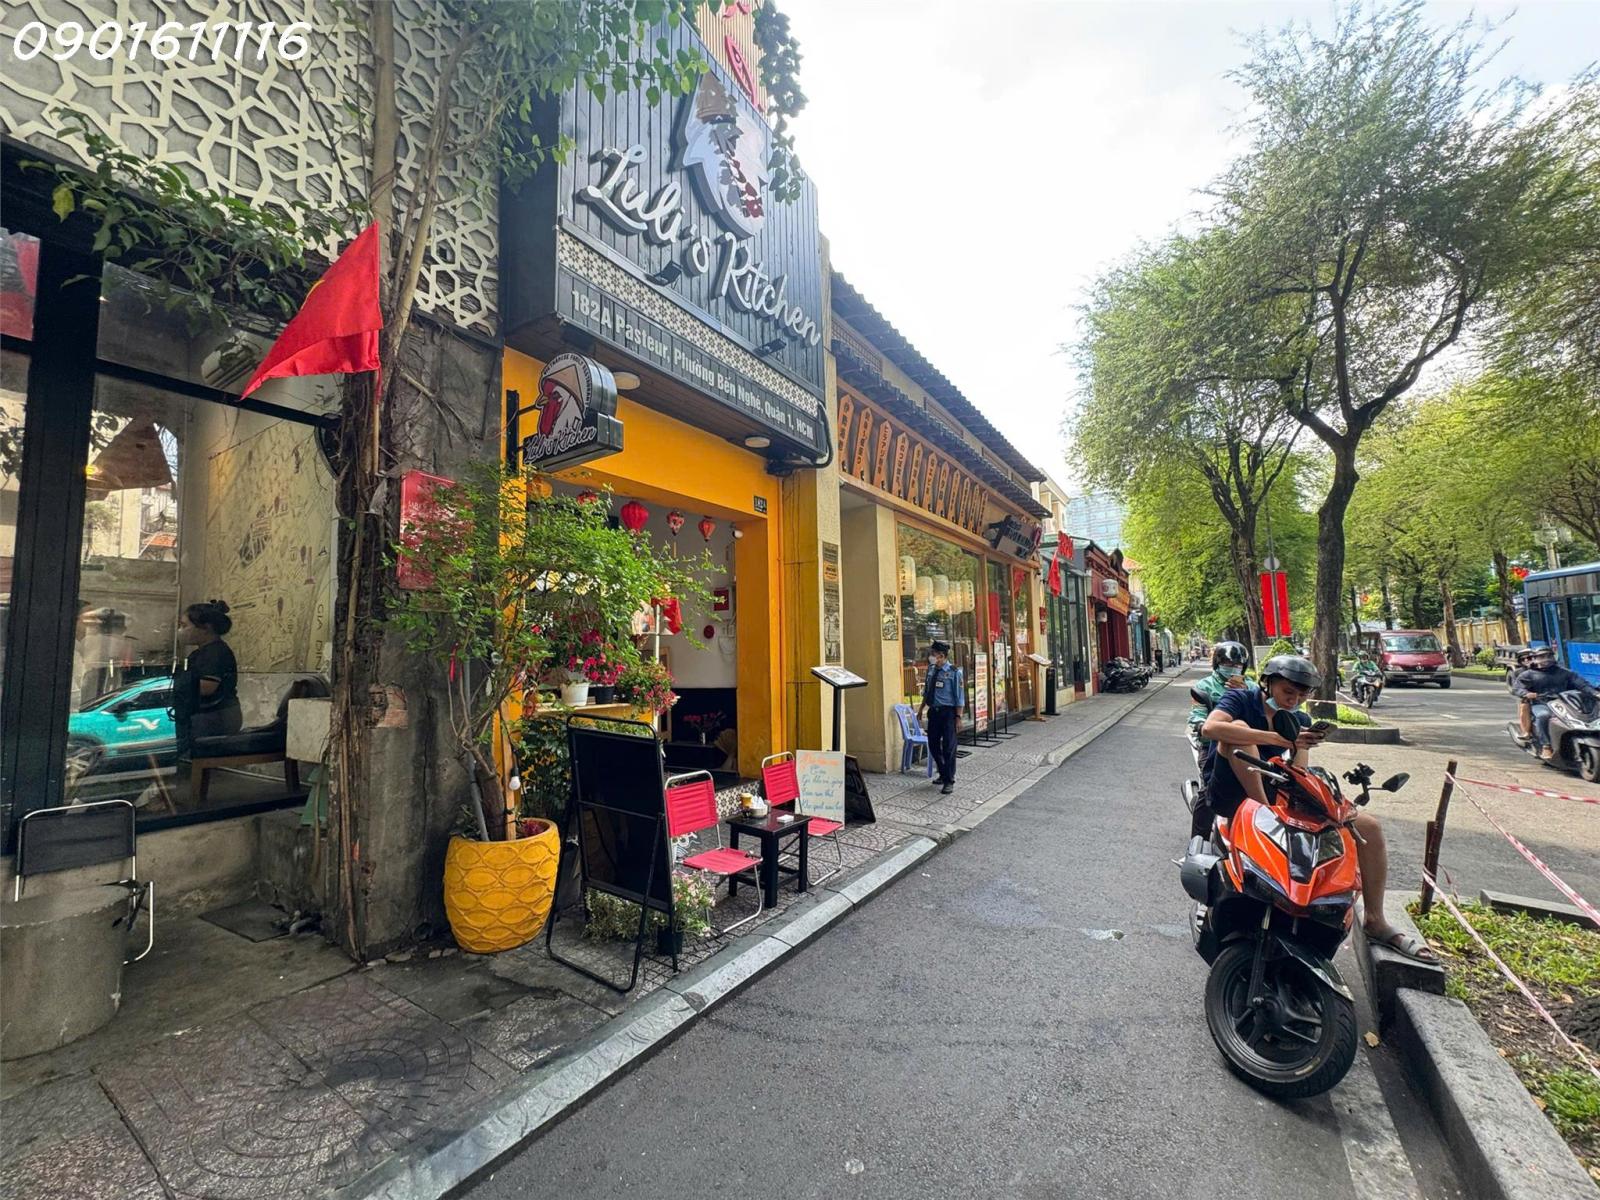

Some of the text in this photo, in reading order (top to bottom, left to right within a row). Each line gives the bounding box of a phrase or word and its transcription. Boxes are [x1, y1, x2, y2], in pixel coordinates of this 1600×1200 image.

[587, 143, 821, 347] Luli's Kitchen
[553, 416, 597, 455] Kitchen
[571, 289, 613, 329] 182A
[615, 313, 671, 363] Pasteur,
[674, 347, 715, 387] Phường
[717, 372, 736, 398] Bến
[764, 400, 786, 425] Quận
[796, 417, 814, 441] HCM
